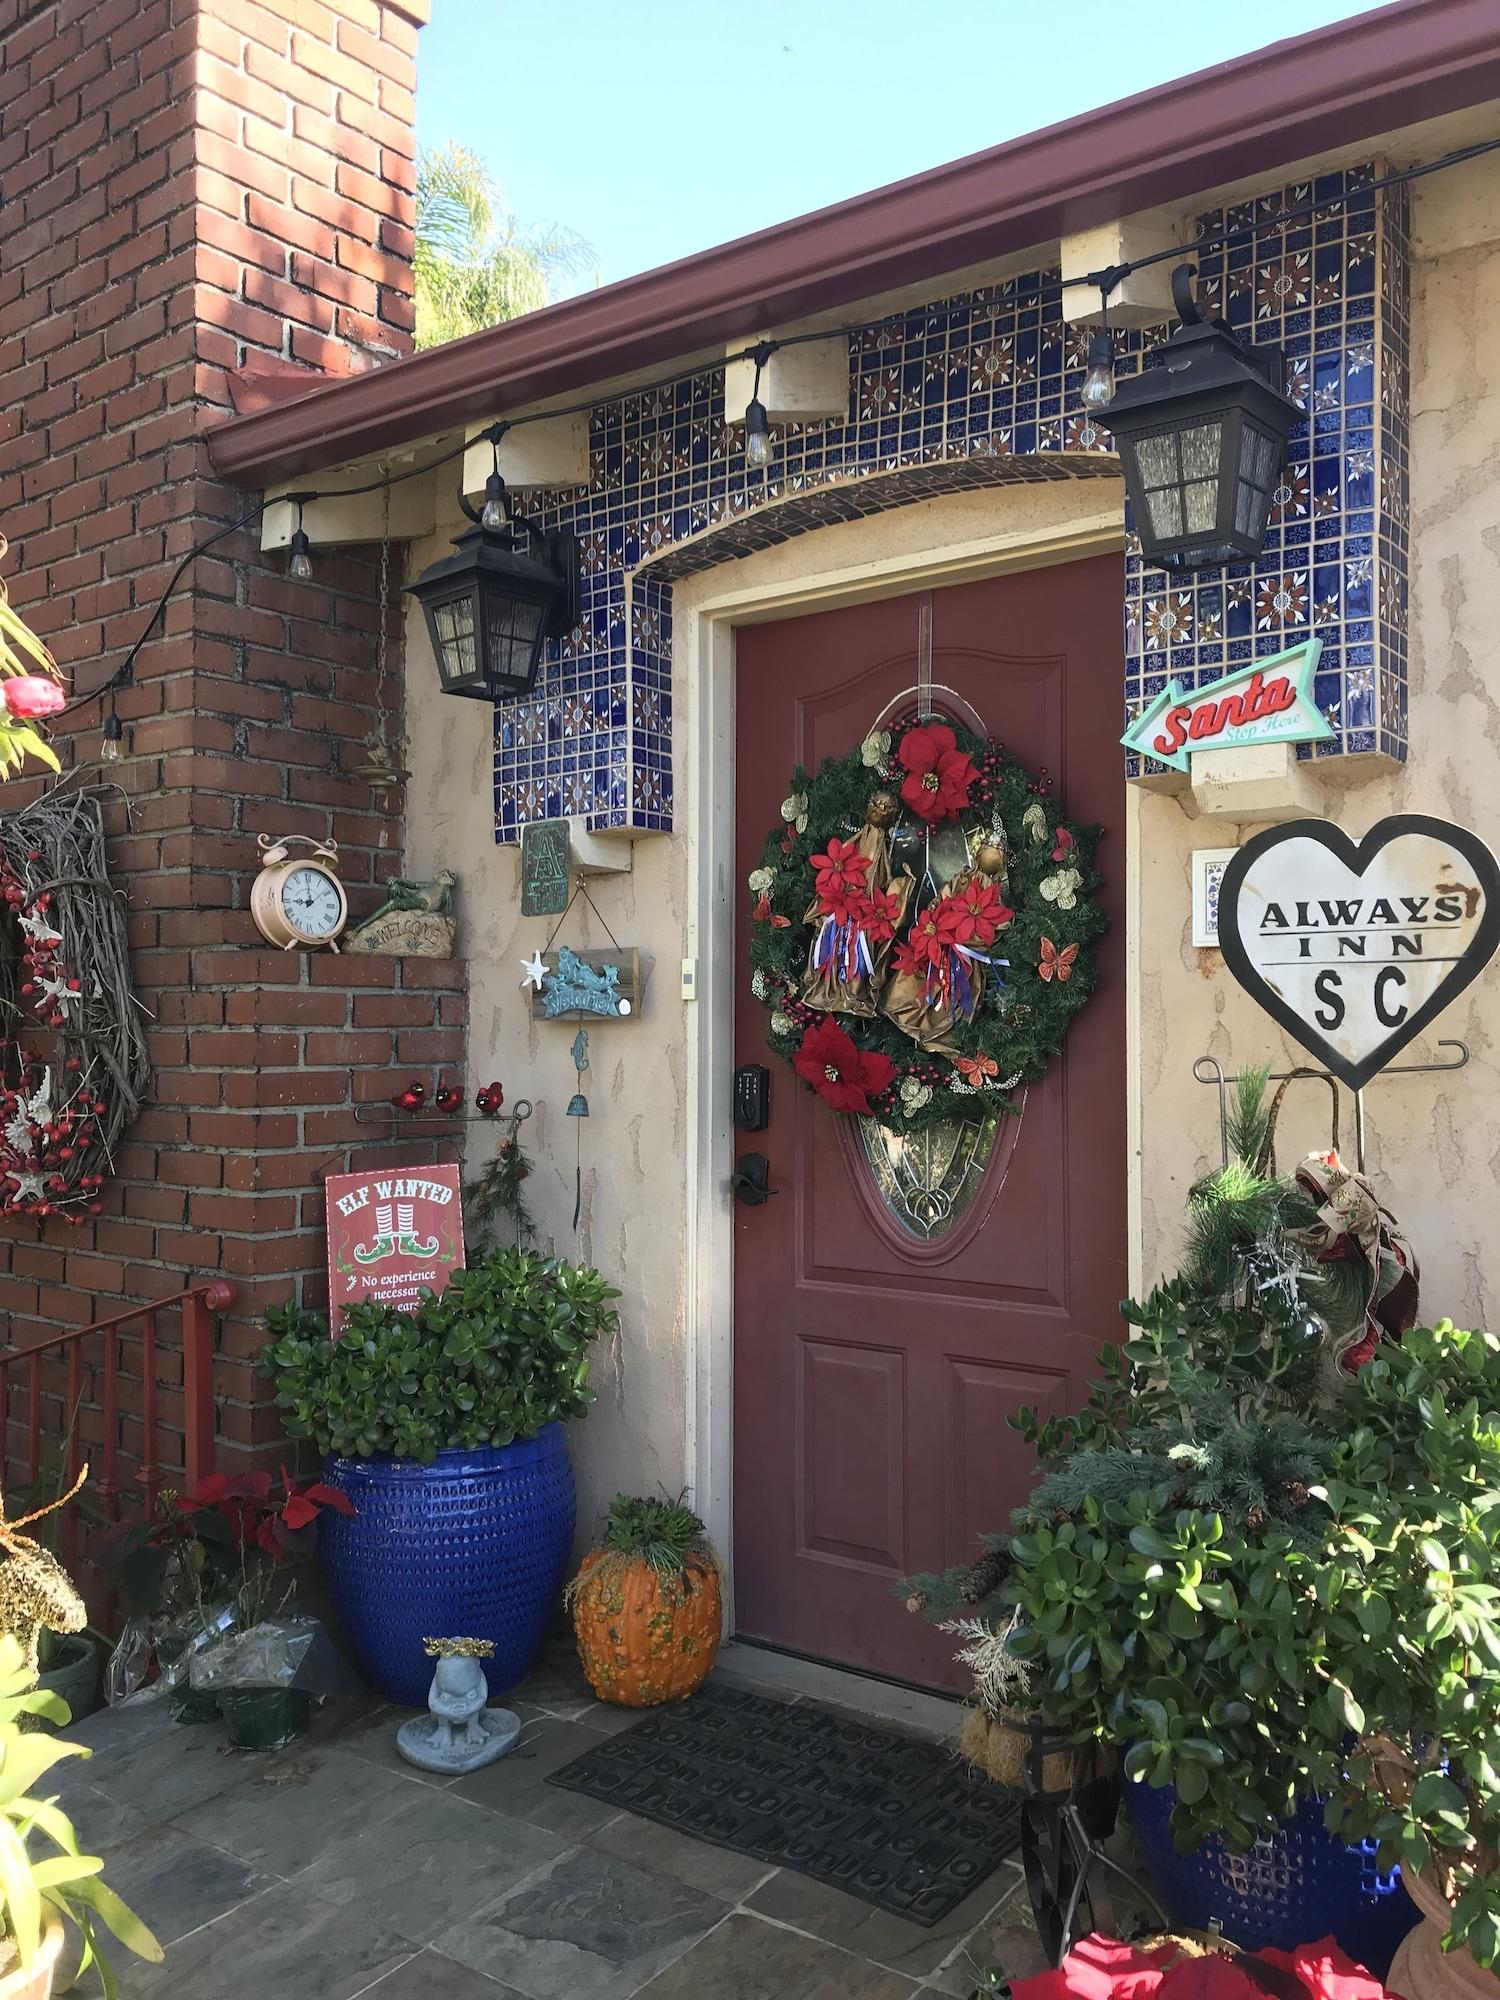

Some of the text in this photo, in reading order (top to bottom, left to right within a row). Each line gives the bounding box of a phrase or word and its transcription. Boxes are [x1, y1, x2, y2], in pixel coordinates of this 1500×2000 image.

[1153, 672, 1297, 755] Santa
[1224, 713, 1301, 741] Stop Here
[1260, 896, 1463, 928] ALWAYS
[376, 920, 444, 945] WELCOME
[336, 1179, 453, 1217] ELF WANTED
[361, 1270, 437, 1289] No experience
[374, 1286, 424, 1300] necessar
